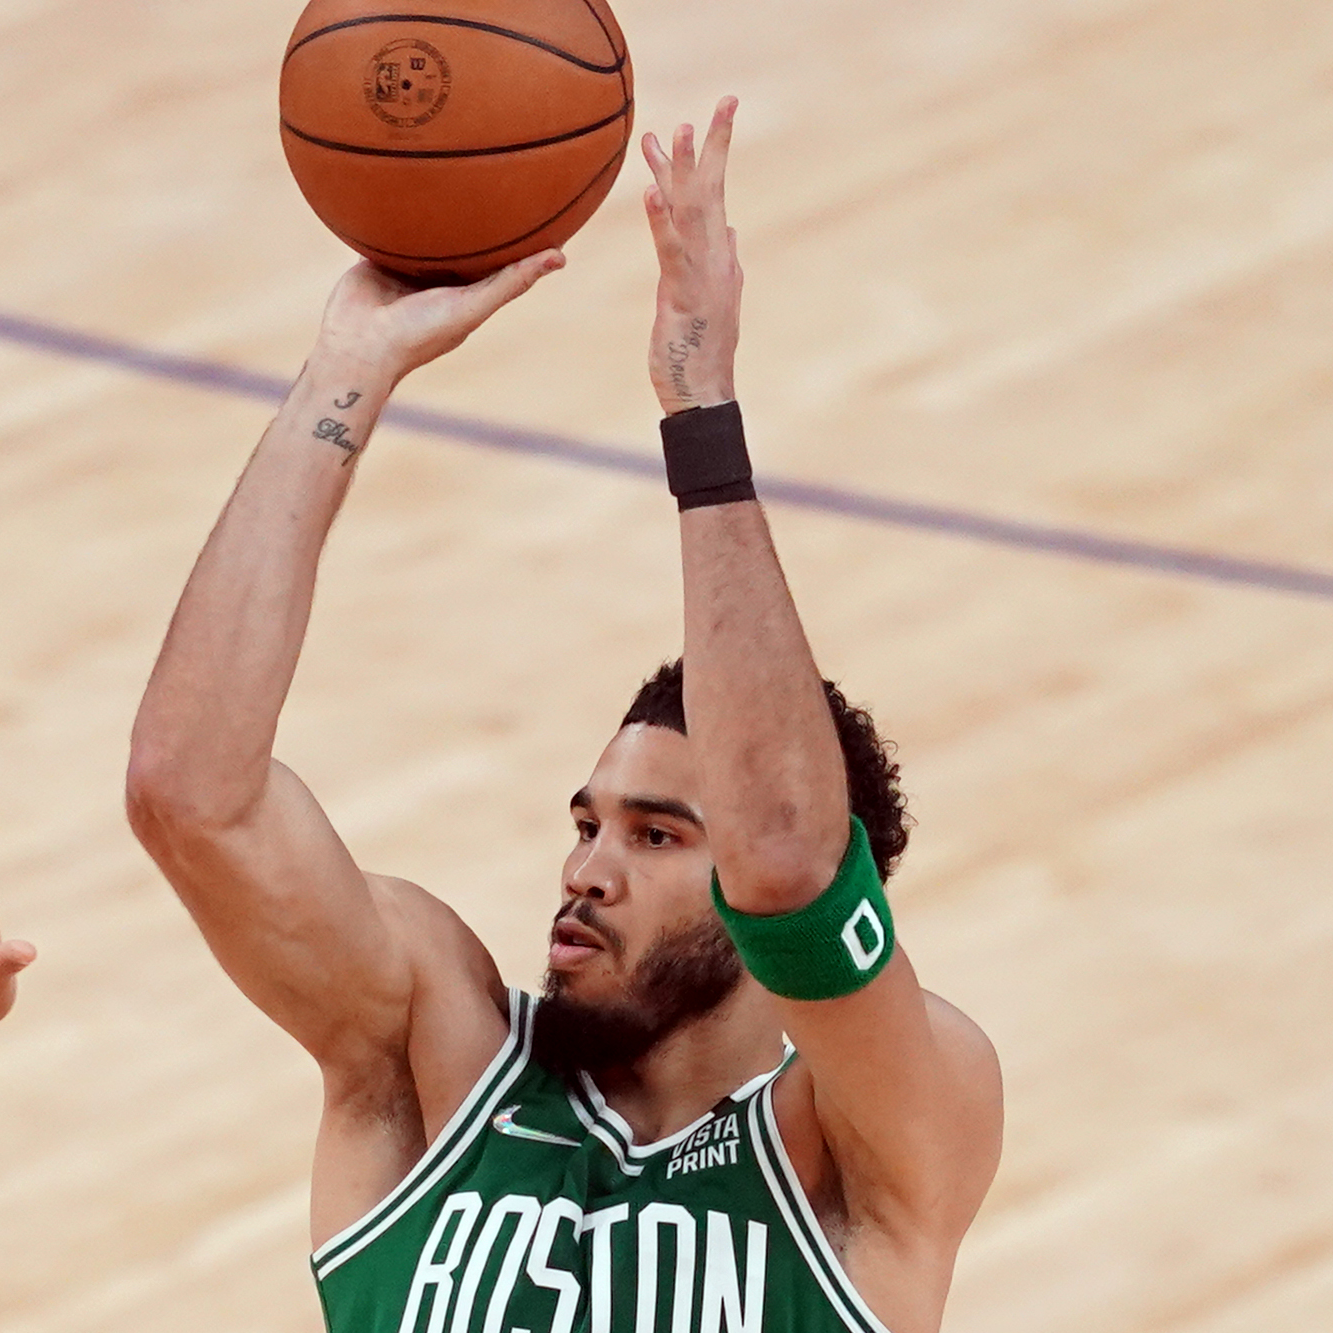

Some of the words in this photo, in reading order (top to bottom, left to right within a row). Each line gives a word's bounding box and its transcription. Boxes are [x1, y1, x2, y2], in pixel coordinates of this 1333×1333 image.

[840, 897, 885, 971] 0
[666, 1138, 741, 1180] PRINT
[672, 1112, 740, 1159] VISTA
